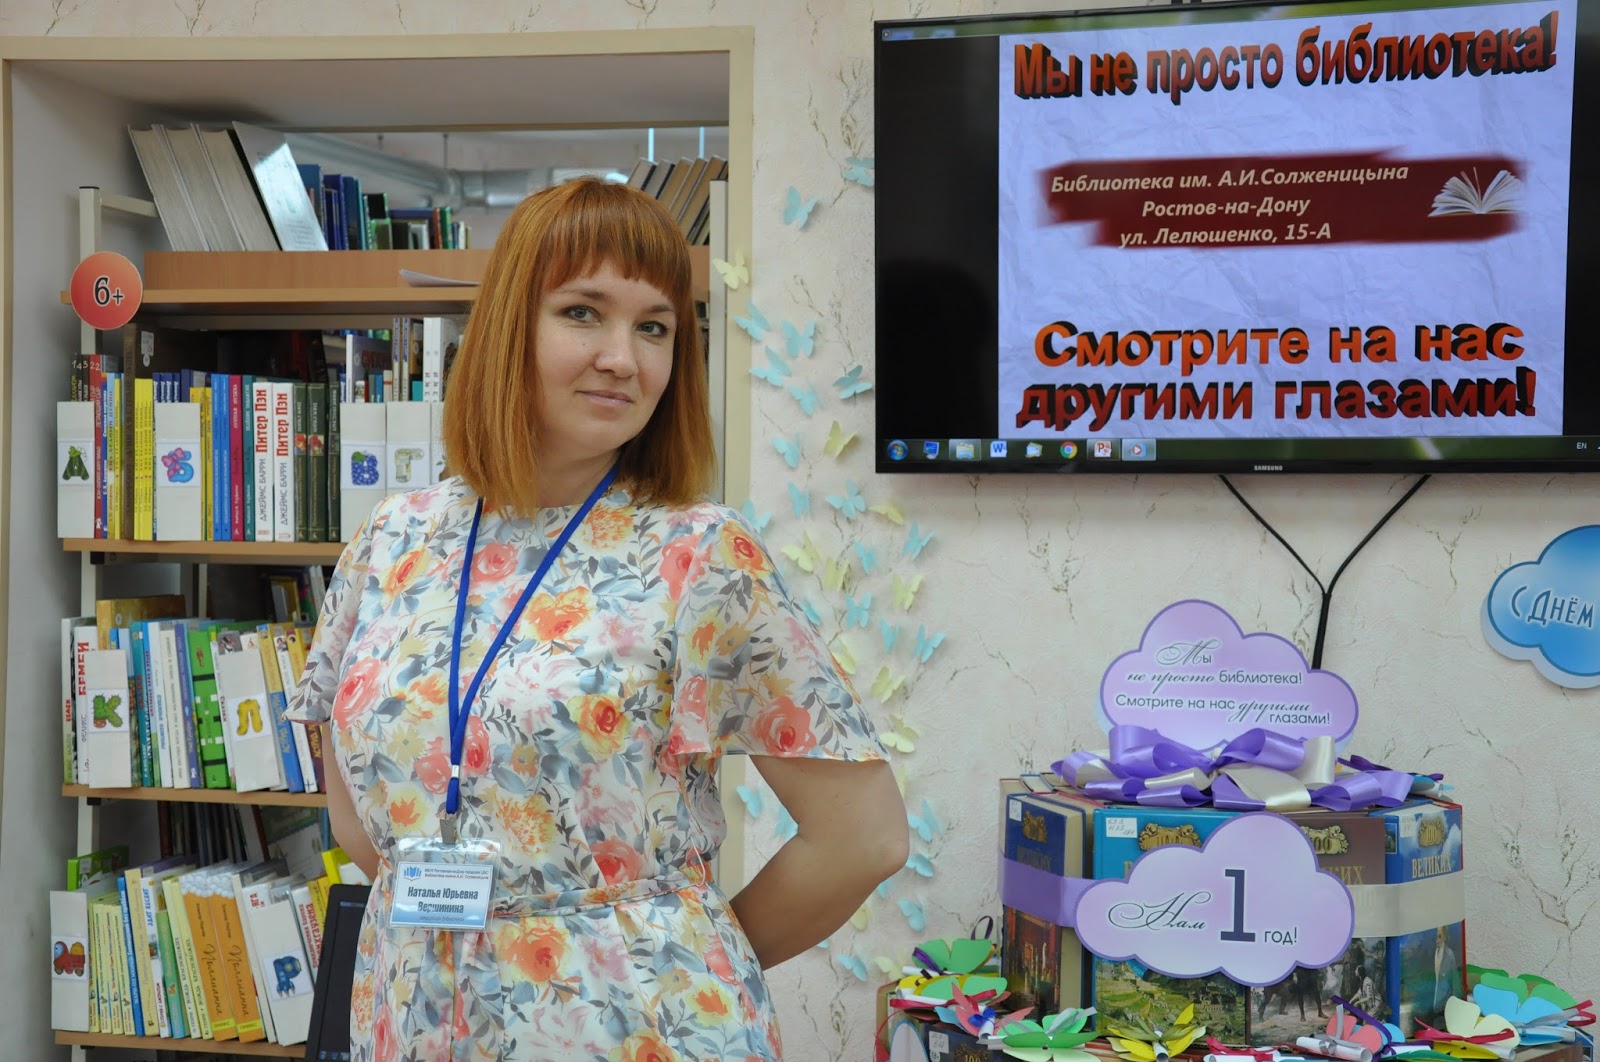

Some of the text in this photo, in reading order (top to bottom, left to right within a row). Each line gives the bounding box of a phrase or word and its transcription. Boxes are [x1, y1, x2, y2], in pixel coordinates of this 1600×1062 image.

[1014, 10, 1559, 105] Мы не просто библиотека!
[1051, 164, 1409, 193] Библиотека им. А.И.Солженицына
[1142, 196, 1310, 220] Ростов-на-Дону
[1118, 223, 1332, 249] ул. Лелюшенко, 15-А
[94, 276, 124, 305] 6+
[1034, 321, 1524, 376] Смотрите на нас
[1016, 367, 1536, 433] другими глазами!
[254, 389, 268, 522] ДЖЕЙМС БАРРИ Питер Пэн
[275, 393, 289, 526] ДЖЕЙМС БАРРИ Питер Пэн
[1577, 442, 1587, 450] EN
[1511, 586, 1527, 617] С
[1156, 639, 1220, 665] Мы
[1127, 670, 1302, 694] не просто библиотека!
[1115, 694, 1311, 723] Смотрите на нас другими
[1269, 713, 1331, 725] глазами!
[1411, 854, 1452, 879] ВЕЛИКИХ
[249, 892, 258, 909] -ЯГА
[407, 886, 478, 899] Наталья Юрьевна
[1108, 868, 1299, 946] Нам 1 год!
[200, 943, 224, 1016] Поллианна
[227, 944, 250, 1017] Поллианна
